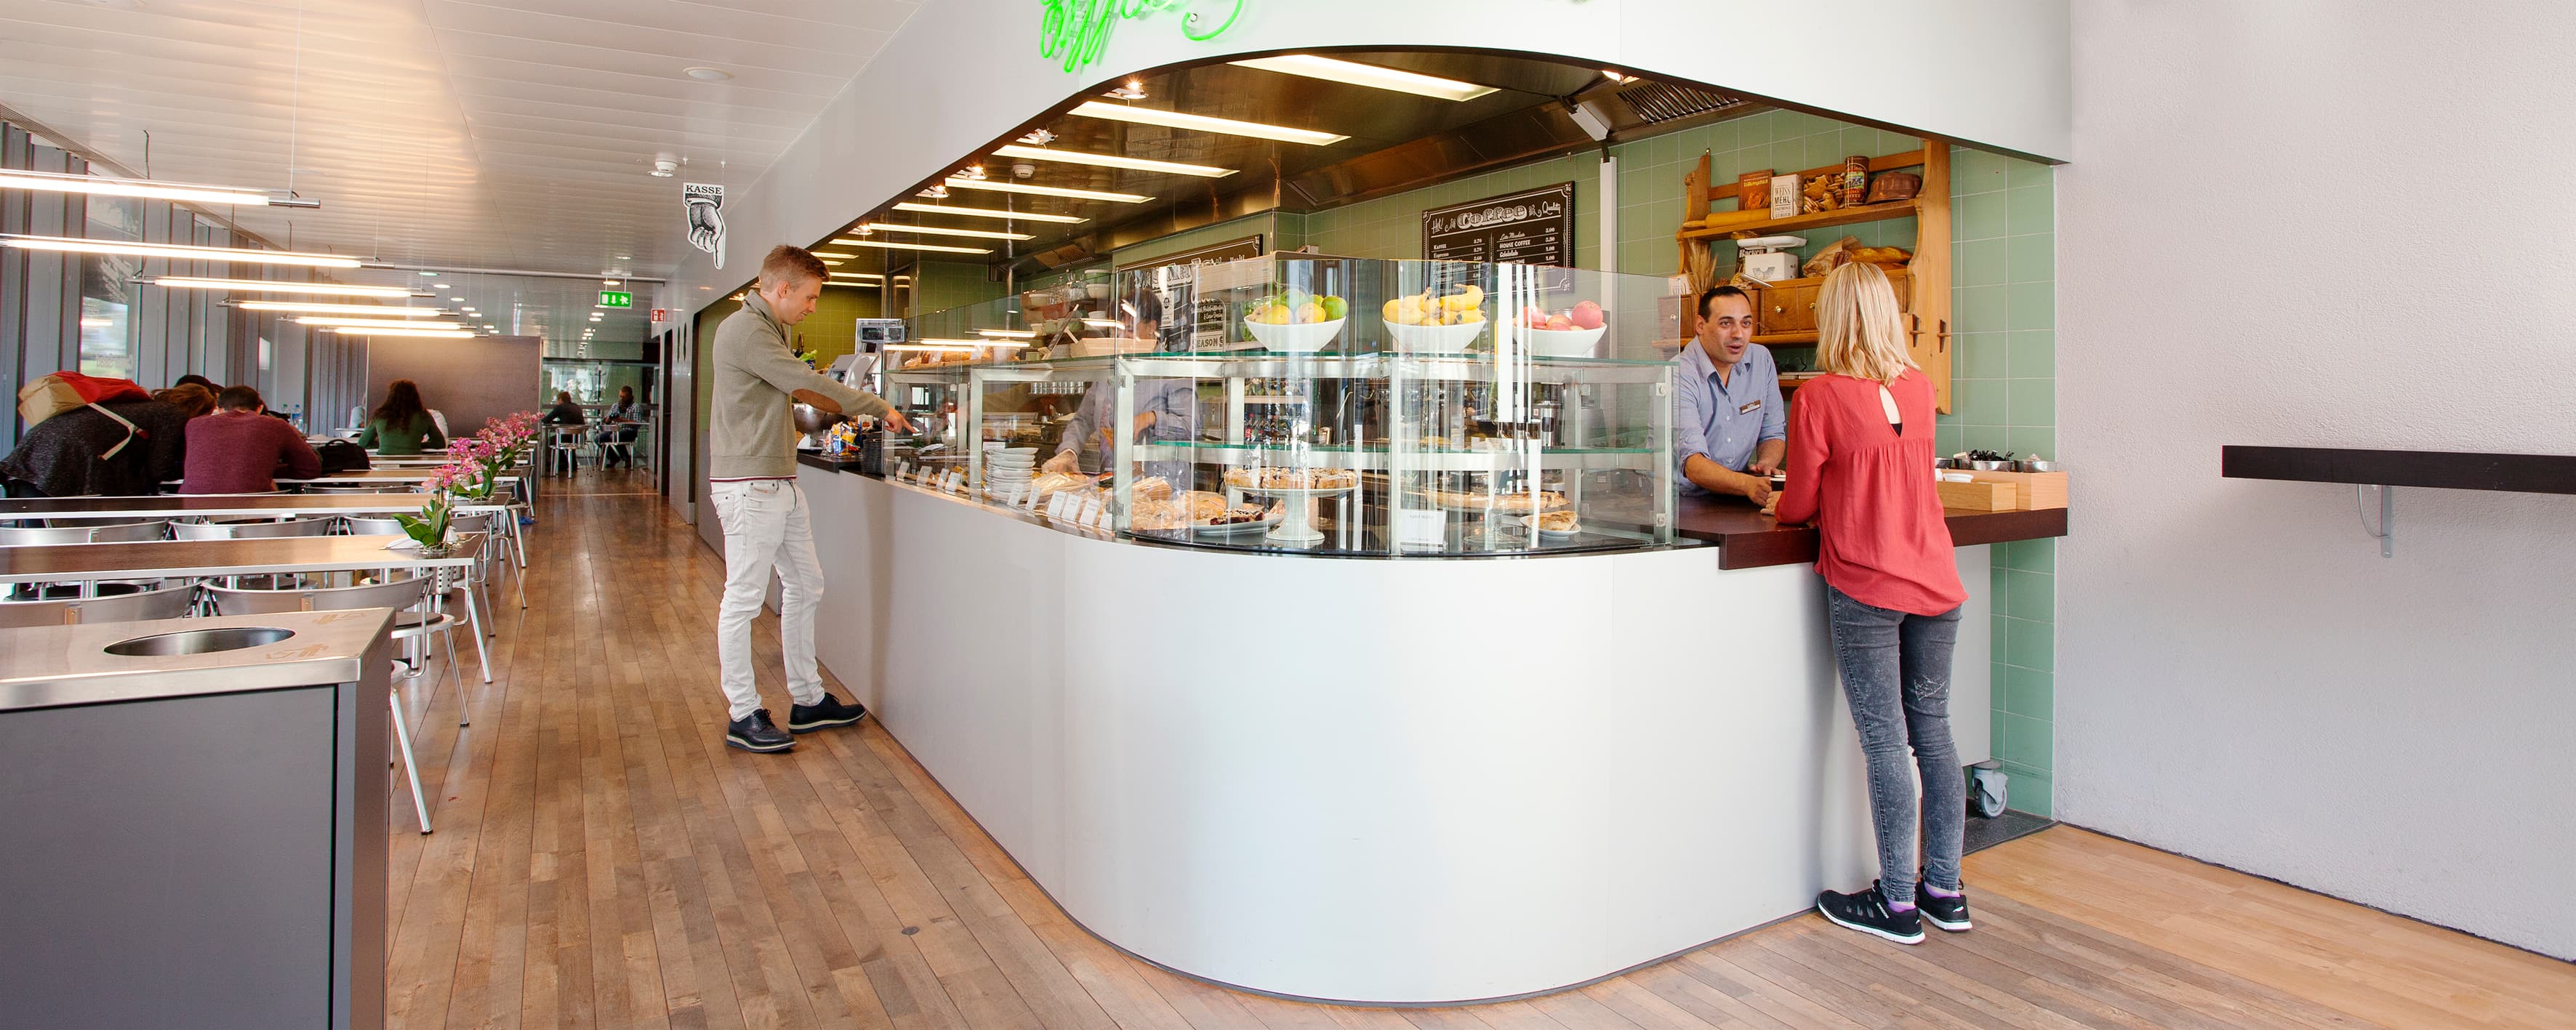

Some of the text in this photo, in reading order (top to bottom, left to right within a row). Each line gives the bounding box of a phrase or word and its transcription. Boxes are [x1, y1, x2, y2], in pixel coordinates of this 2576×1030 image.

[686, 185, 722, 195] KASSE
[1457, 206, 1527, 229] Coffee
[1192, 338, 1218, 347] EASON
